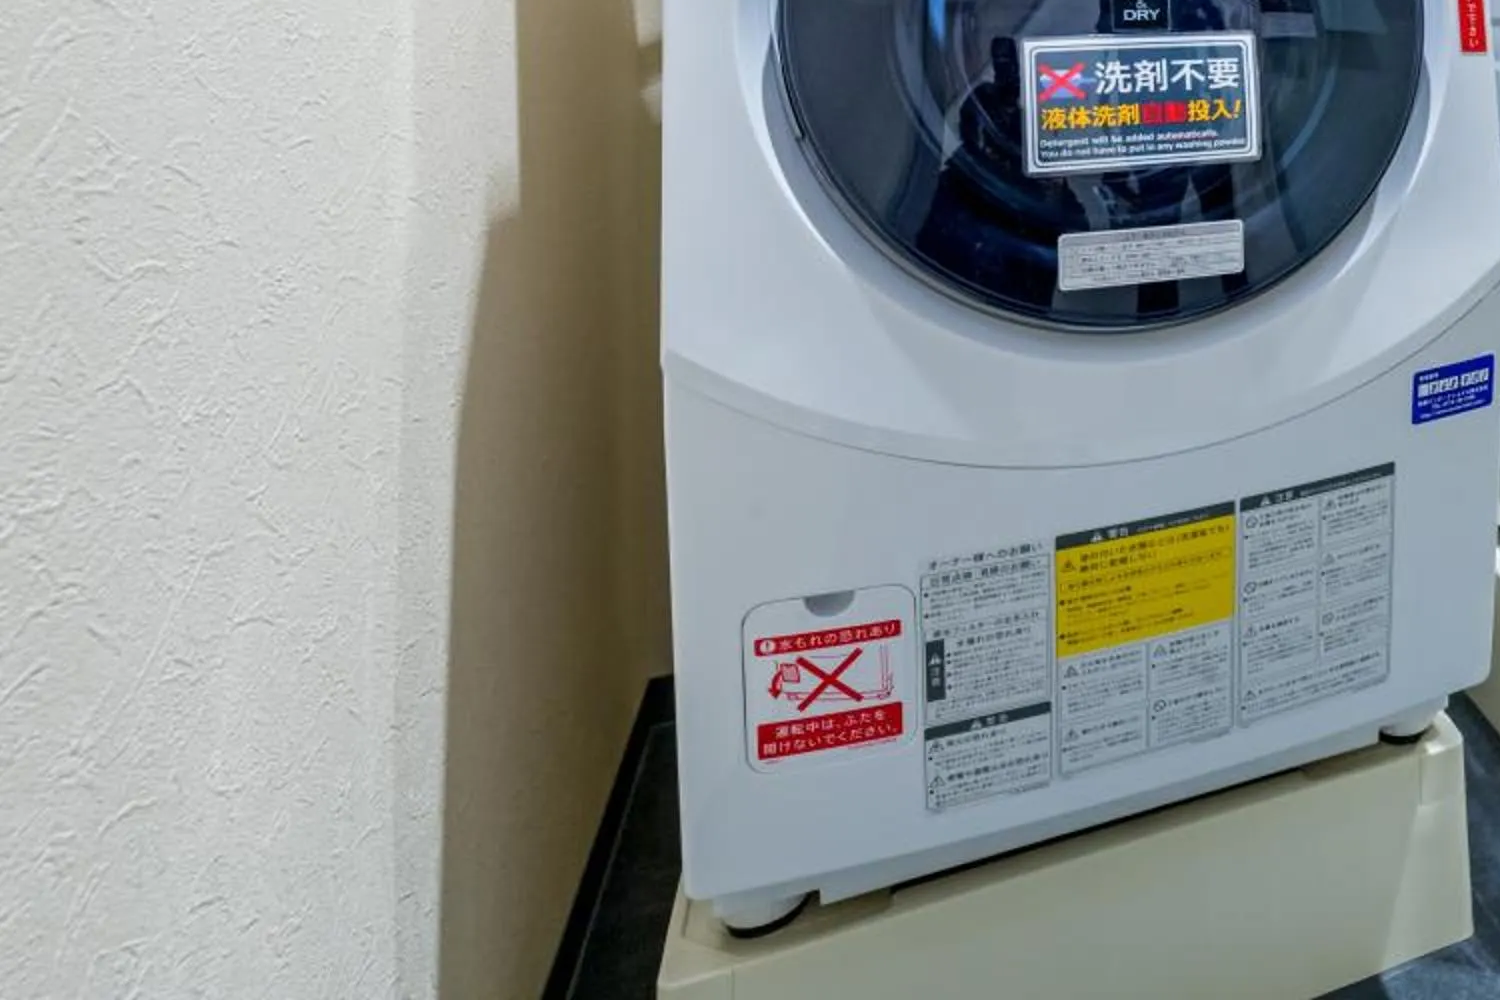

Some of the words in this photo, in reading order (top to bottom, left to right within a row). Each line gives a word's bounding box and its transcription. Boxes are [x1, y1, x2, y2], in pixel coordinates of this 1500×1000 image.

[1122, 8, 1160, 22] DRY
[1094, 57, 1241, 95] 洗剤不要
[778, 624, 896, 649] 水もれの恐れあり
[775, 709, 887, 738] 運転中は、ふたを
[763, 724, 898, 755] 開けないでください。
